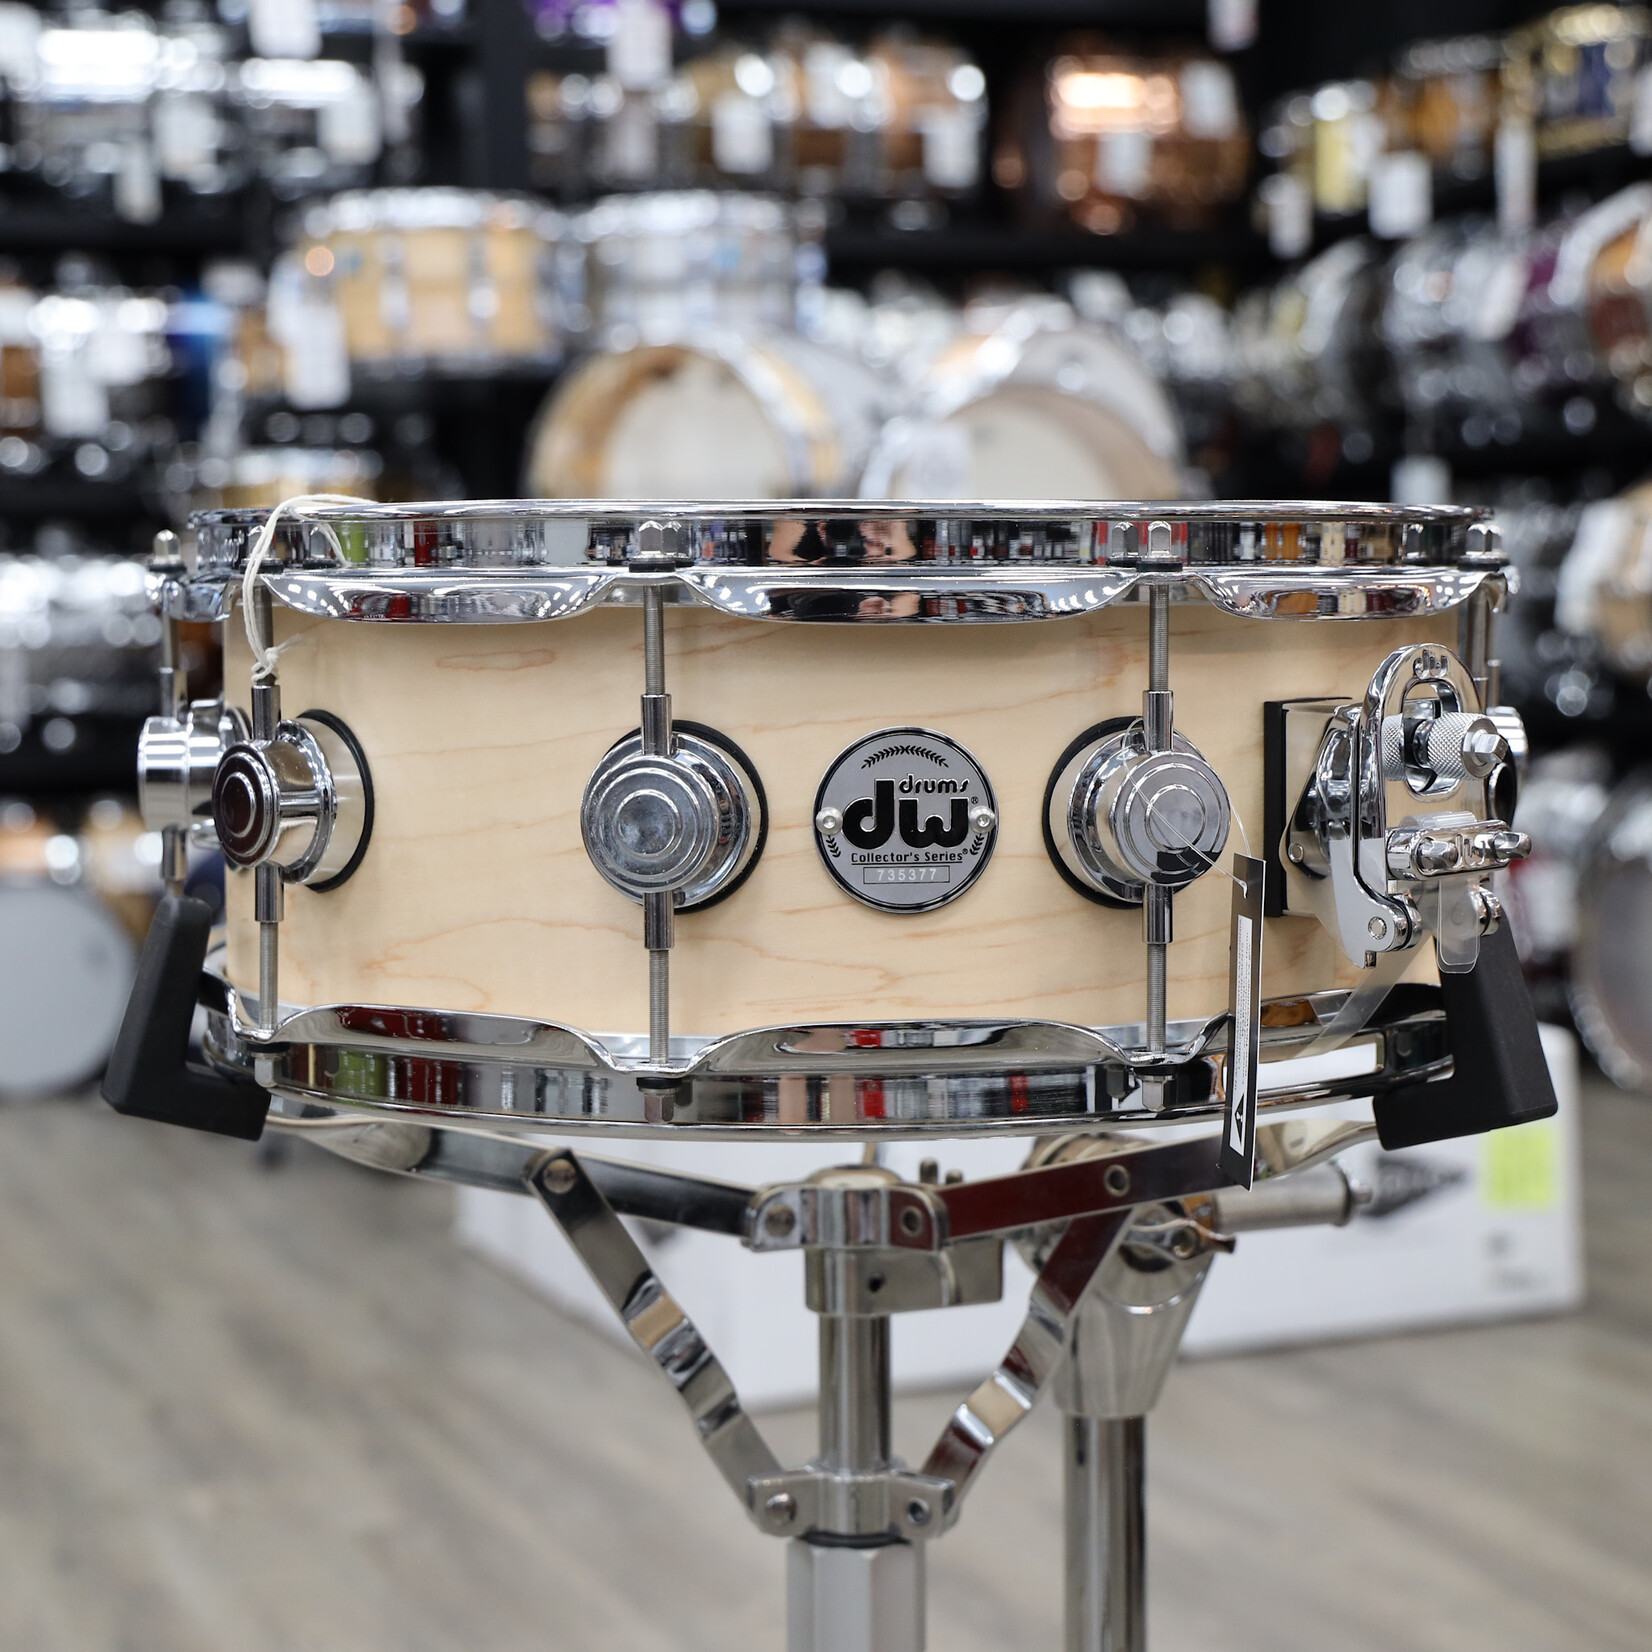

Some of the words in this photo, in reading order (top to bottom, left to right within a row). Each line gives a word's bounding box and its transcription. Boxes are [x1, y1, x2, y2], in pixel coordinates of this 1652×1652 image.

[899, 773, 970, 794] drums
[842, 779, 969, 849] dw
[851, 852, 919, 863] Collector's
[877, 868, 937, 881] 735377
